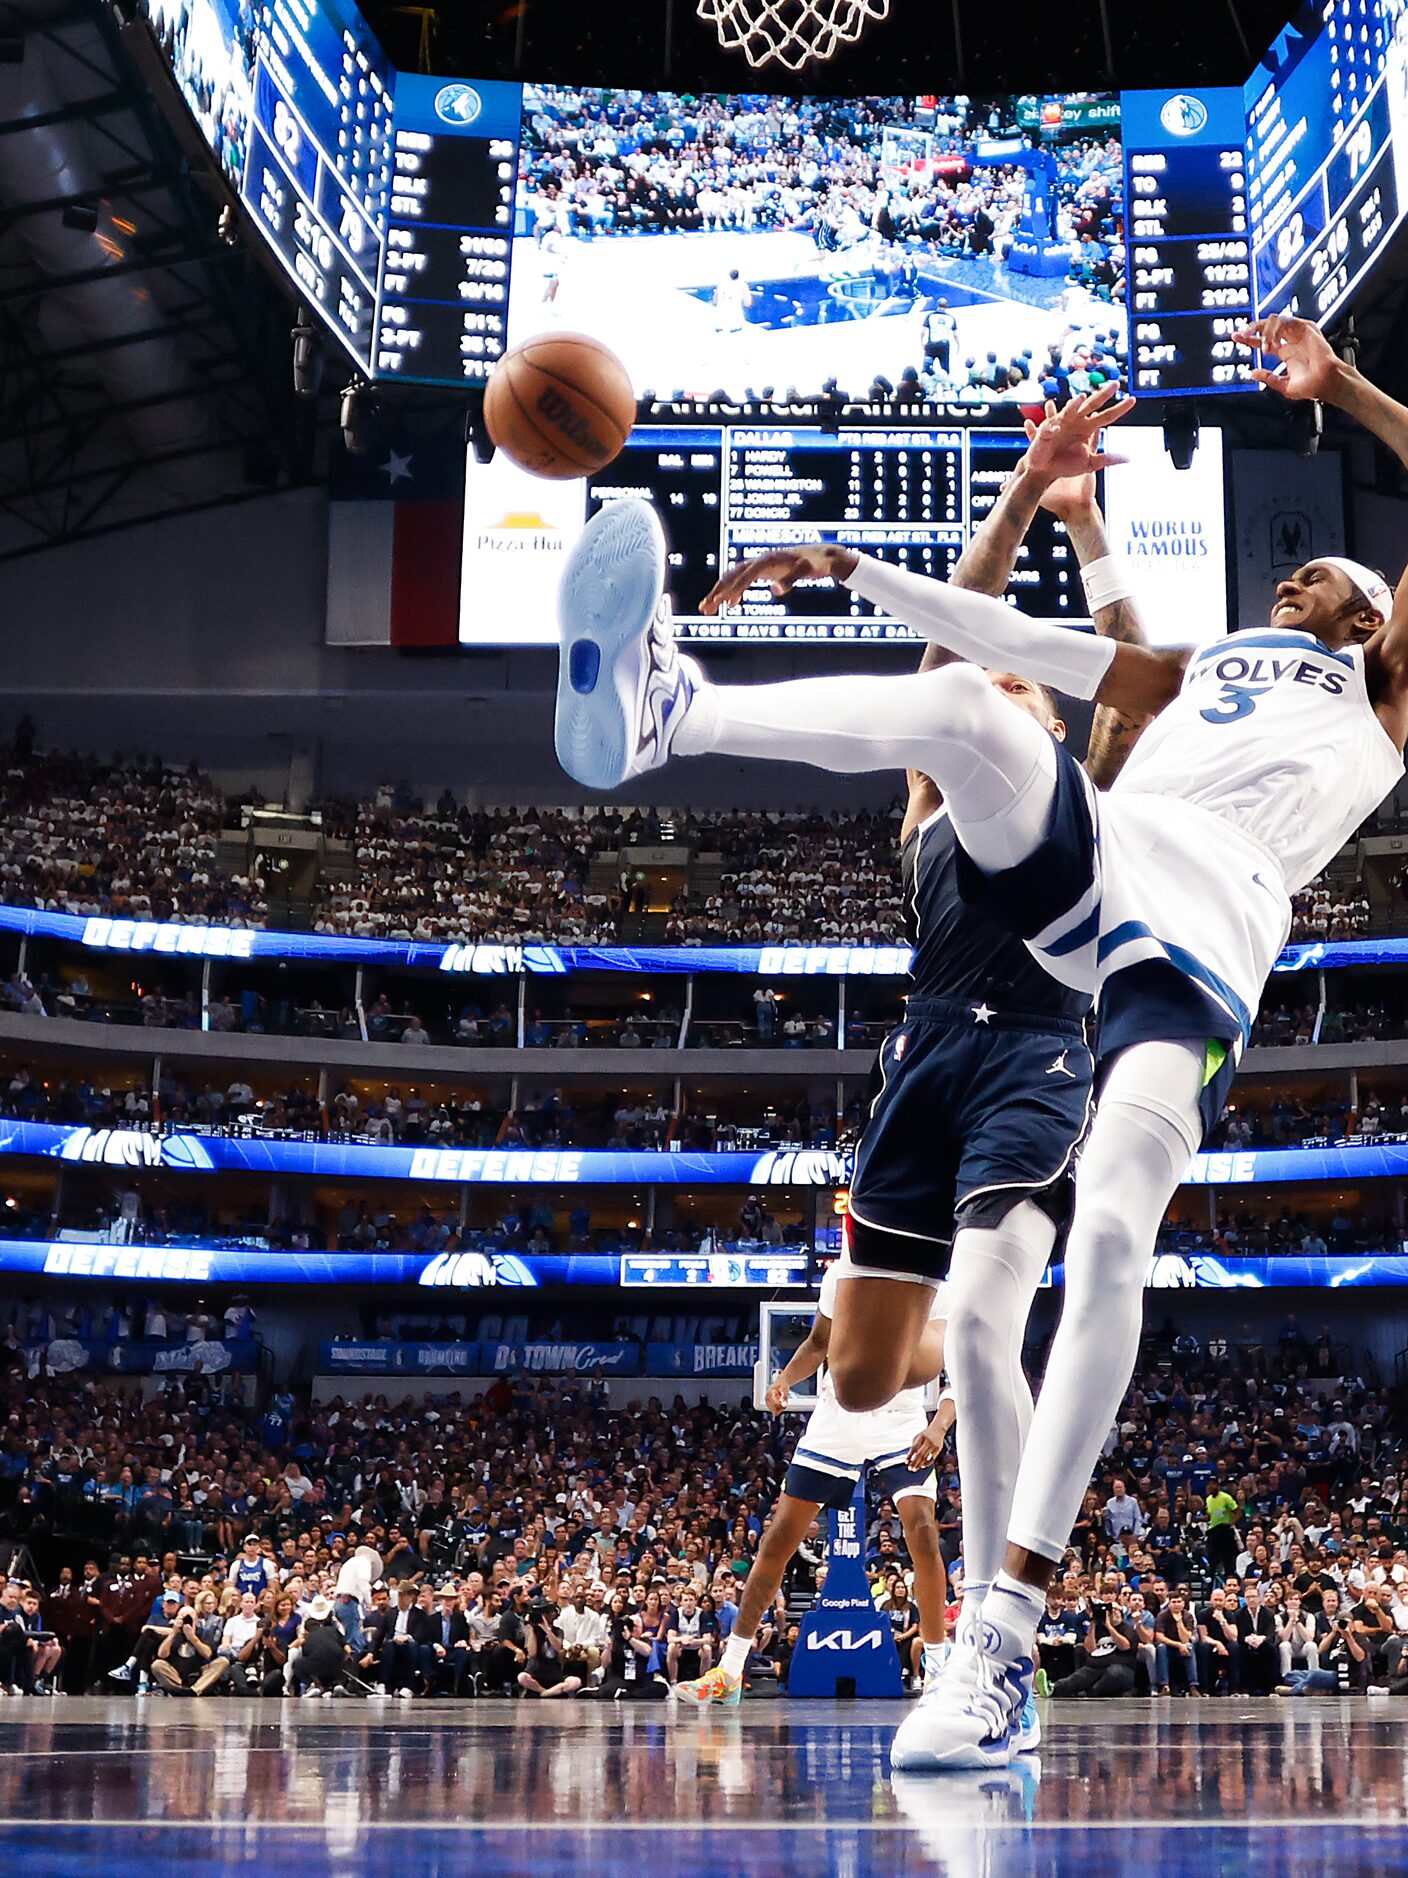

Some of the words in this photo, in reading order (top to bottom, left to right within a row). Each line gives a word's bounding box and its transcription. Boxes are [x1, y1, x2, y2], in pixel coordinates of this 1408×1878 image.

[1088, 104, 1120, 117] shift
[274, 100, 300, 165] 82
[1346, 120, 1371, 179] 79
[395, 152, 419, 170] TO
[1220, 151, 1243, 168] 22
[392, 176, 427, 194] BLK
[500, 186, 511, 202] 1
[1133, 176, 1157, 192] TO
[390, 196, 421, 215] STL
[495, 205, 508, 222] 2
[1133, 199, 1167, 216] BLK
[339, 193, 364, 252] 79
[1134, 220, 1164, 236] STL
[294, 201, 332, 269] 2:16
[1277, 212, 1304, 269] 82
[1135, 247, 1158, 264] FG
[1311, 217, 1349, 286] 2:16
[386, 251, 425, 270] 3-PT
[466, 258, 505, 277] 7/20
[1136, 268, 1174, 286] 3-PT
[1204, 264, 1249, 281] 11/23
[384, 274, 407, 291] FT
[458, 281, 504, 300] 10/14
[1136, 292, 1157, 309] FT
[1202, 288, 1249, 306] 21/24
[380, 328, 420, 347] 3-PT
[1137, 323, 1161, 340] FG
[379, 352, 402, 369] FT
[1138, 345, 1176, 363] 3-PT
[1138, 369, 1160, 387] FT
[733, 431, 793, 446] DALLAS
[658, 454, 684, 467] DAL
[730, 451, 738, 463] 1
[744, 451, 787, 463] HARDY
[874, 451, 883, 463] 2
[730, 465, 738, 477] 7
[744, 465, 793, 477] POWELL
[850, 465, 860, 477] 2
[877, 465, 883, 477] 1
[925, 465, 931, 477] 1
[946, 465, 956, 477] 2
[745, 479, 822, 491] WASHINGTON
[848, 479, 861, 491] 11
[900, 479, 907, 491] 1
[949, 479, 956, 491] 1
[590, 486, 654, 499] PERSONAL
[670, 492, 684, 505] 14
[848, 493, 861, 505] 11
[877, 493, 883, 505] 1
[898, 493, 907, 505] 2
[946, 493, 956, 505] 2
[729, 507, 744, 519] 77
[844, 507, 860, 519] 23
[874, 507, 883, 519] 4
[898, 507, 907, 519] 4
[922, 507, 931, 519] 4
[732, 529, 822, 543] MINNESOTA
[1130, 520, 1202, 538] WORLD
[477, 535, 523, 551] Pizza
[534, 535, 563, 551] Hut
[1052, 546, 1067, 558] 22
[1127, 538, 1208, 556] FAMOUS
[706, 553, 716, 566] 2
[728, 548, 737, 559] 3
[877, 548, 883, 559] 1
[947, 548, 956, 559] 3
[688, 625, 731, 637] YOUR
[736, 625, 779, 637] MAVS
[784, 625, 827, 637] GEAR
[833, 625, 856, 637] ON
[860, 625, 880, 637] AT
[1188, 657, 1347, 695] WOLVES
[1199, 683, 1274, 724] 3
[81, 917, 256, 957] DEFENSE
[409, 1150, 582, 1182] DEFENSE
[43, 1244, 214, 1280] DEFENSE
[523, 1345, 577, 1370] TOWN
[693, 1346, 780, 1372] BREAKES
[837, 1507, 856, 1522] GET
[838, 1523, 856, 1538] THE
[841, 1540, 860, 1558] App
[822, 1599, 850, 1609] Google
[851, 1599, 869, 1607] Pixel
[807, 1630, 882, 1650] KIA
